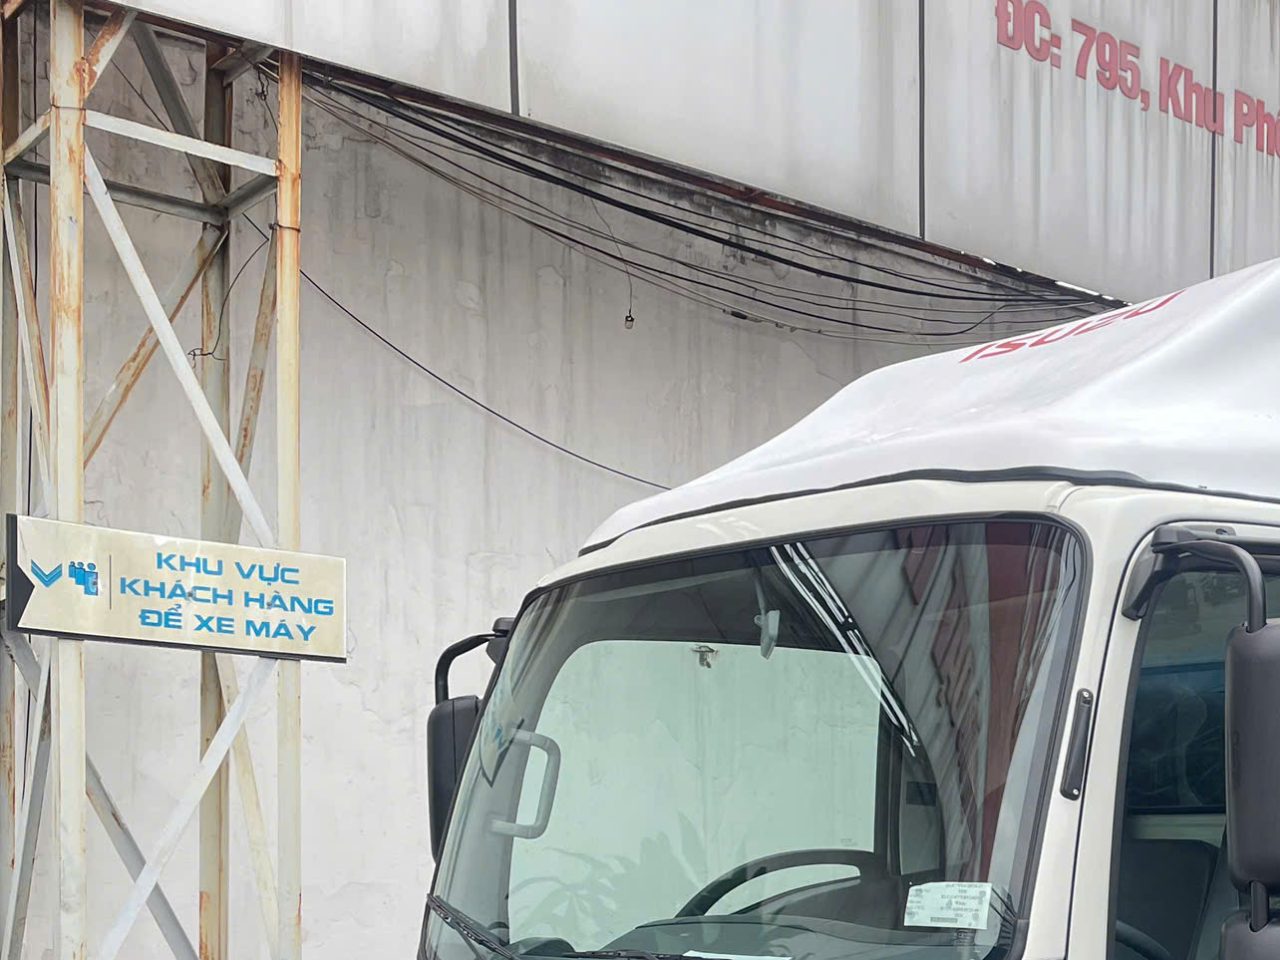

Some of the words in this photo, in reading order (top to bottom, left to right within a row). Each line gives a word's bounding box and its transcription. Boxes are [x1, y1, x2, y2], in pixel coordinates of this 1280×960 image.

[1071, 18, 1150, 112] 795,
[1159, 56, 1224, 136] Khu
[156, 552, 223, 577] KHU
[235, 561, 300, 586] VỰC
[120, 576, 234, 606] KHÁCH
[244, 590, 335, 617] HÀNG
[139, 604, 183, 630] ĐỂ
[194, 614, 235, 635] XE
[245, 618, 317, 643] MÁY
